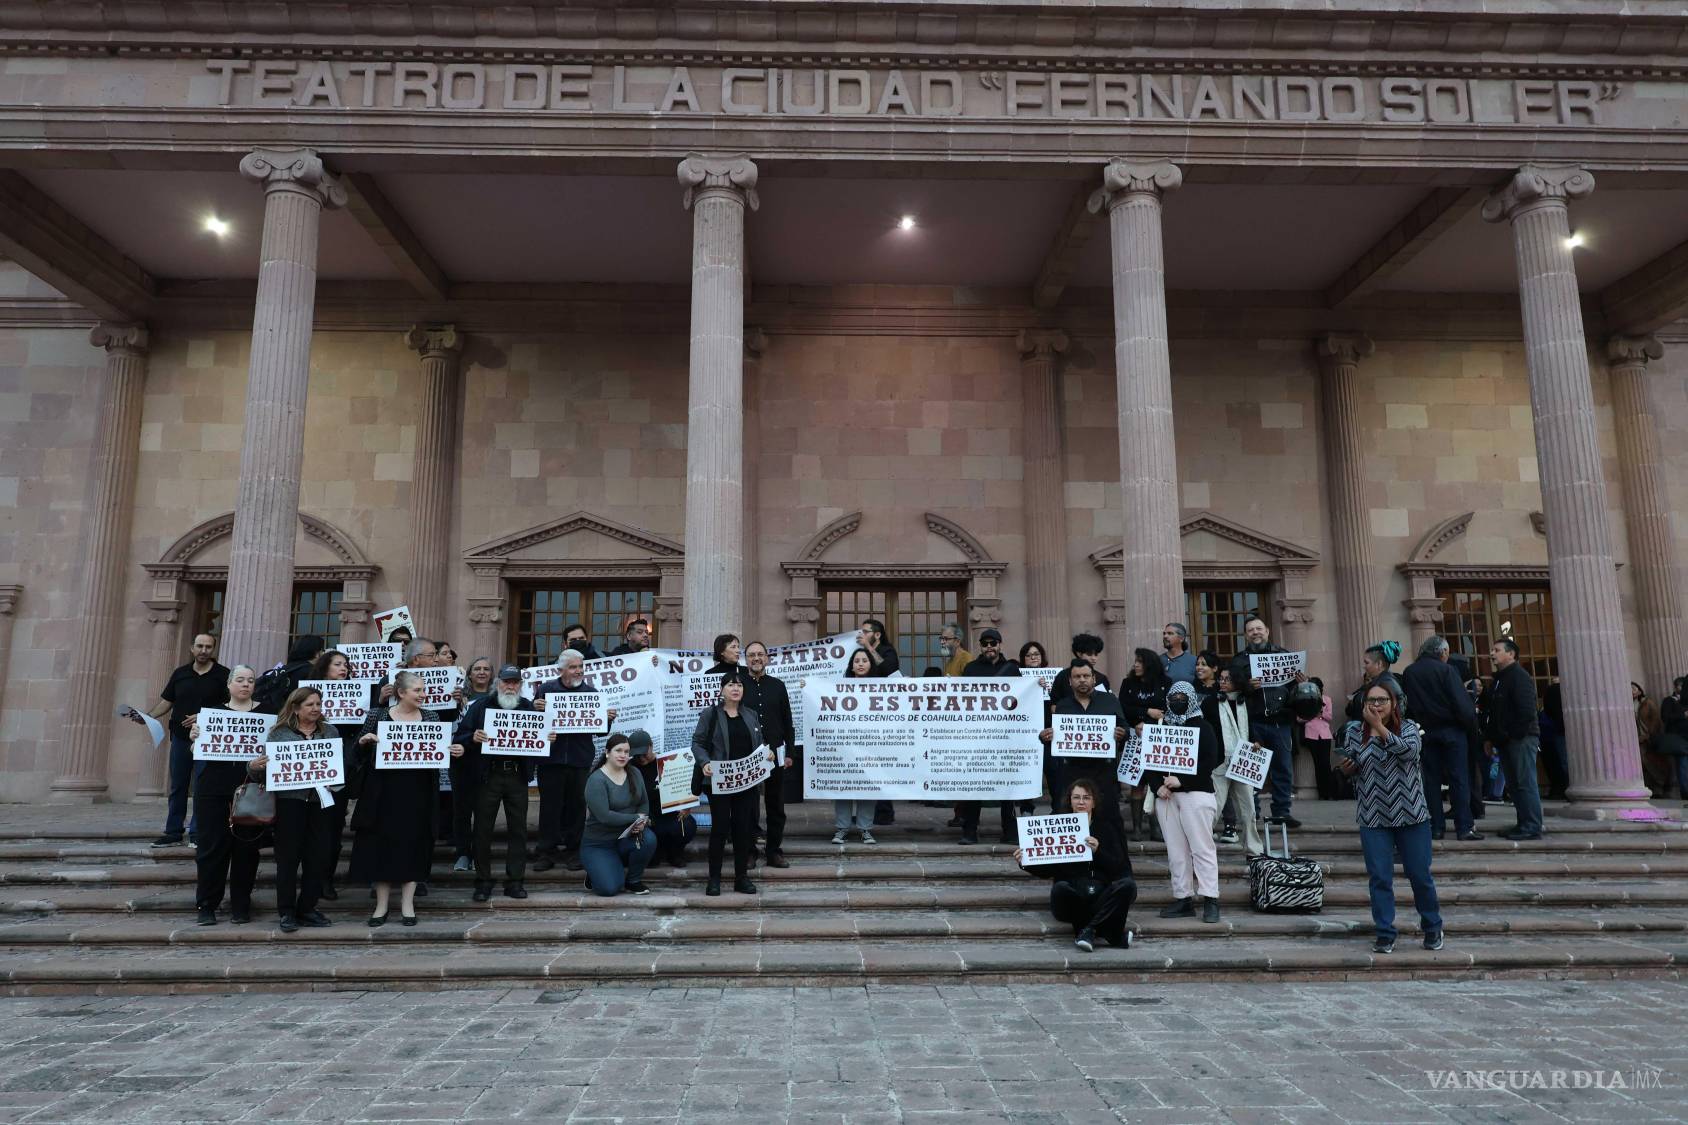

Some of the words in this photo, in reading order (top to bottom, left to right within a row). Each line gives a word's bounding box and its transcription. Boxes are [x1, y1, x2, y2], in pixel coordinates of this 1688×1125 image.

[206, 58, 487, 109] TEATRO
[503, 64, 593, 110] DE
[612, 65, 701, 112] LA
[719, 67, 964, 116] CIUDAD
[768, 646, 845, 666] EATRO
[585, 659, 624, 672] ATRO
[669, 659, 703, 673] NO
[778, 662, 834, 673] DEMANDAMOS:
[352, 670, 386, 678] EATR
[1256, 671, 1294, 682] TEATR
[428, 686, 444, 694] ES
[836, 684, 855, 692] UN
[859, 684, 918, 692] TEATRO
[923, 683, 947, 692] SIN
[951, 683, 1011, 692] TEATRO
[340, 700, 356, 708] ES
[821, 696, 858, 711] NO
[869, 696, 899, 711] ES
[908, 696, 1018, 711] TEATRO
[558, 710, 576, 718] NO
[858, 713, 905, 721] ESCÉNICOS
[552, 719, 603, 727] TEATRO
[497, 729, 518, 738] NO
[522, 731, 538, 739] ES
[810, 728, 814, 737] 1
[923, 729, 928, 737] 2
[1164, 728, 1193, 736] TEATRO
[211, 734, 234, 744] NO
[240, 735, 258, 744] ES
[1064, 733, 1083, 741] NO
[1088, 734, 1103, 742] ES
[1165, 737, 1194, 745] TEATRO
[294, 742, 332, 752] TEATRO
[392, 742, 414, 751] NO
[419, 742, 436, 751] ES
[488, 738, 545, 749] TEATRO
[1056, 741, 1110, 751] TEATRO
[201, 744, 264, 754] TEATRO
[1152, 745, 1171, 754] NO
[1175, 747, 1189, 756] ES
[296, 750, 334, 760] TEATRO
[382, 752, 444, 761] TEATRO
[735, 752, 762, 766] TEATRO
[923, 751, 928, 760] 4
[1248, 753, 1265, 764] TEATRO
[737, 757, 763, 772] TEATRO
[810, 757, 815, 765] 3
[1145, 754, 1194, 767] TEATRO
[1238, 758, 1249, 767] NO
[1250, 763, 1260, 772] ES
[281, 762, 304, 772] NO
[310, 760, 328, 770] ES
[748, 765, 760, 776] ES
[272, 769, 338, 783] TEATRO
[1231, 764, 1262, 781] TEATRO
[717, 768, 766, 789] TEATRO
[810, 780, 815, 789] 5
[923, 781, 928, 790] 6
[1044, 817, 1078, 826] TEATRO
[1046, 825, 1080, 834] TEATRO
[1033, 837, 1054, 846] NO
[1059, 835, 1076, 844] ES
[1026, 844, 1086, 857] TEATRO
